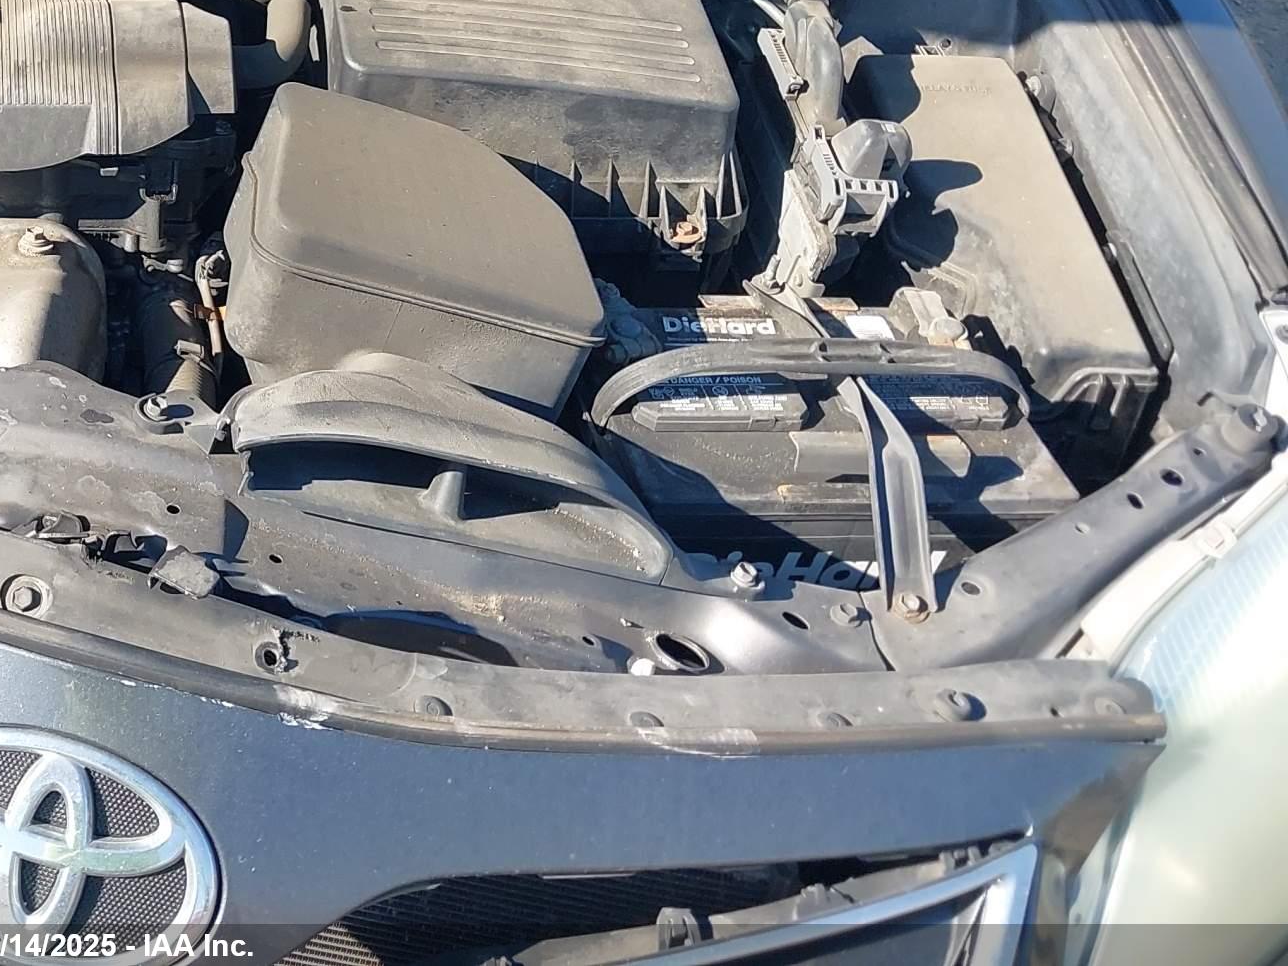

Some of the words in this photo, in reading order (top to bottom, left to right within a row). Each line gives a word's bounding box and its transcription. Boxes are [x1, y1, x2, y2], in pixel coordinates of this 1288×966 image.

[663, 316, 776, 335] DieHard
[670, 376, 713, 385] DANGER
[723, 376, 762, 384] POISON
